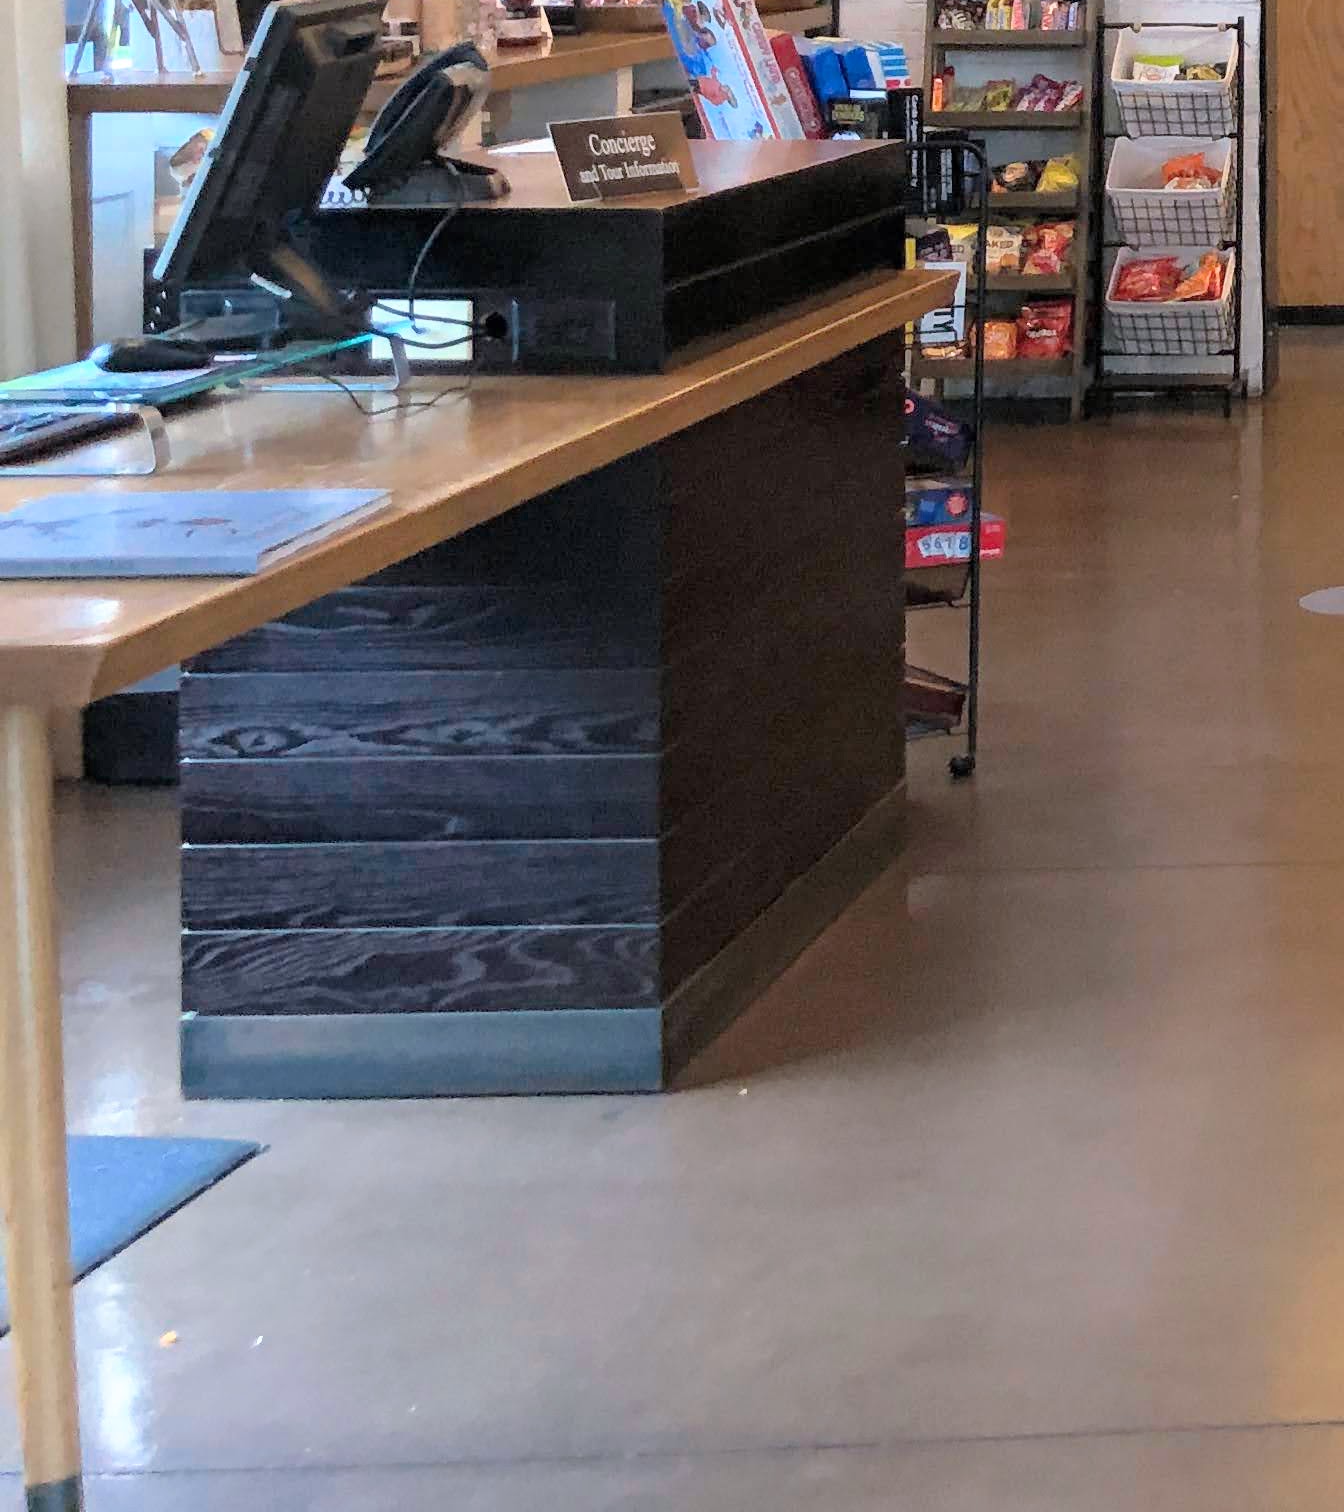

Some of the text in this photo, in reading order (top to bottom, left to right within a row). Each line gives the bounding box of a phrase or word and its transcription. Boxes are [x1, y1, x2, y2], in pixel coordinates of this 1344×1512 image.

[588, 130, 656, 157] Concierge
[579, 159, 680, 183] and Tour Information
